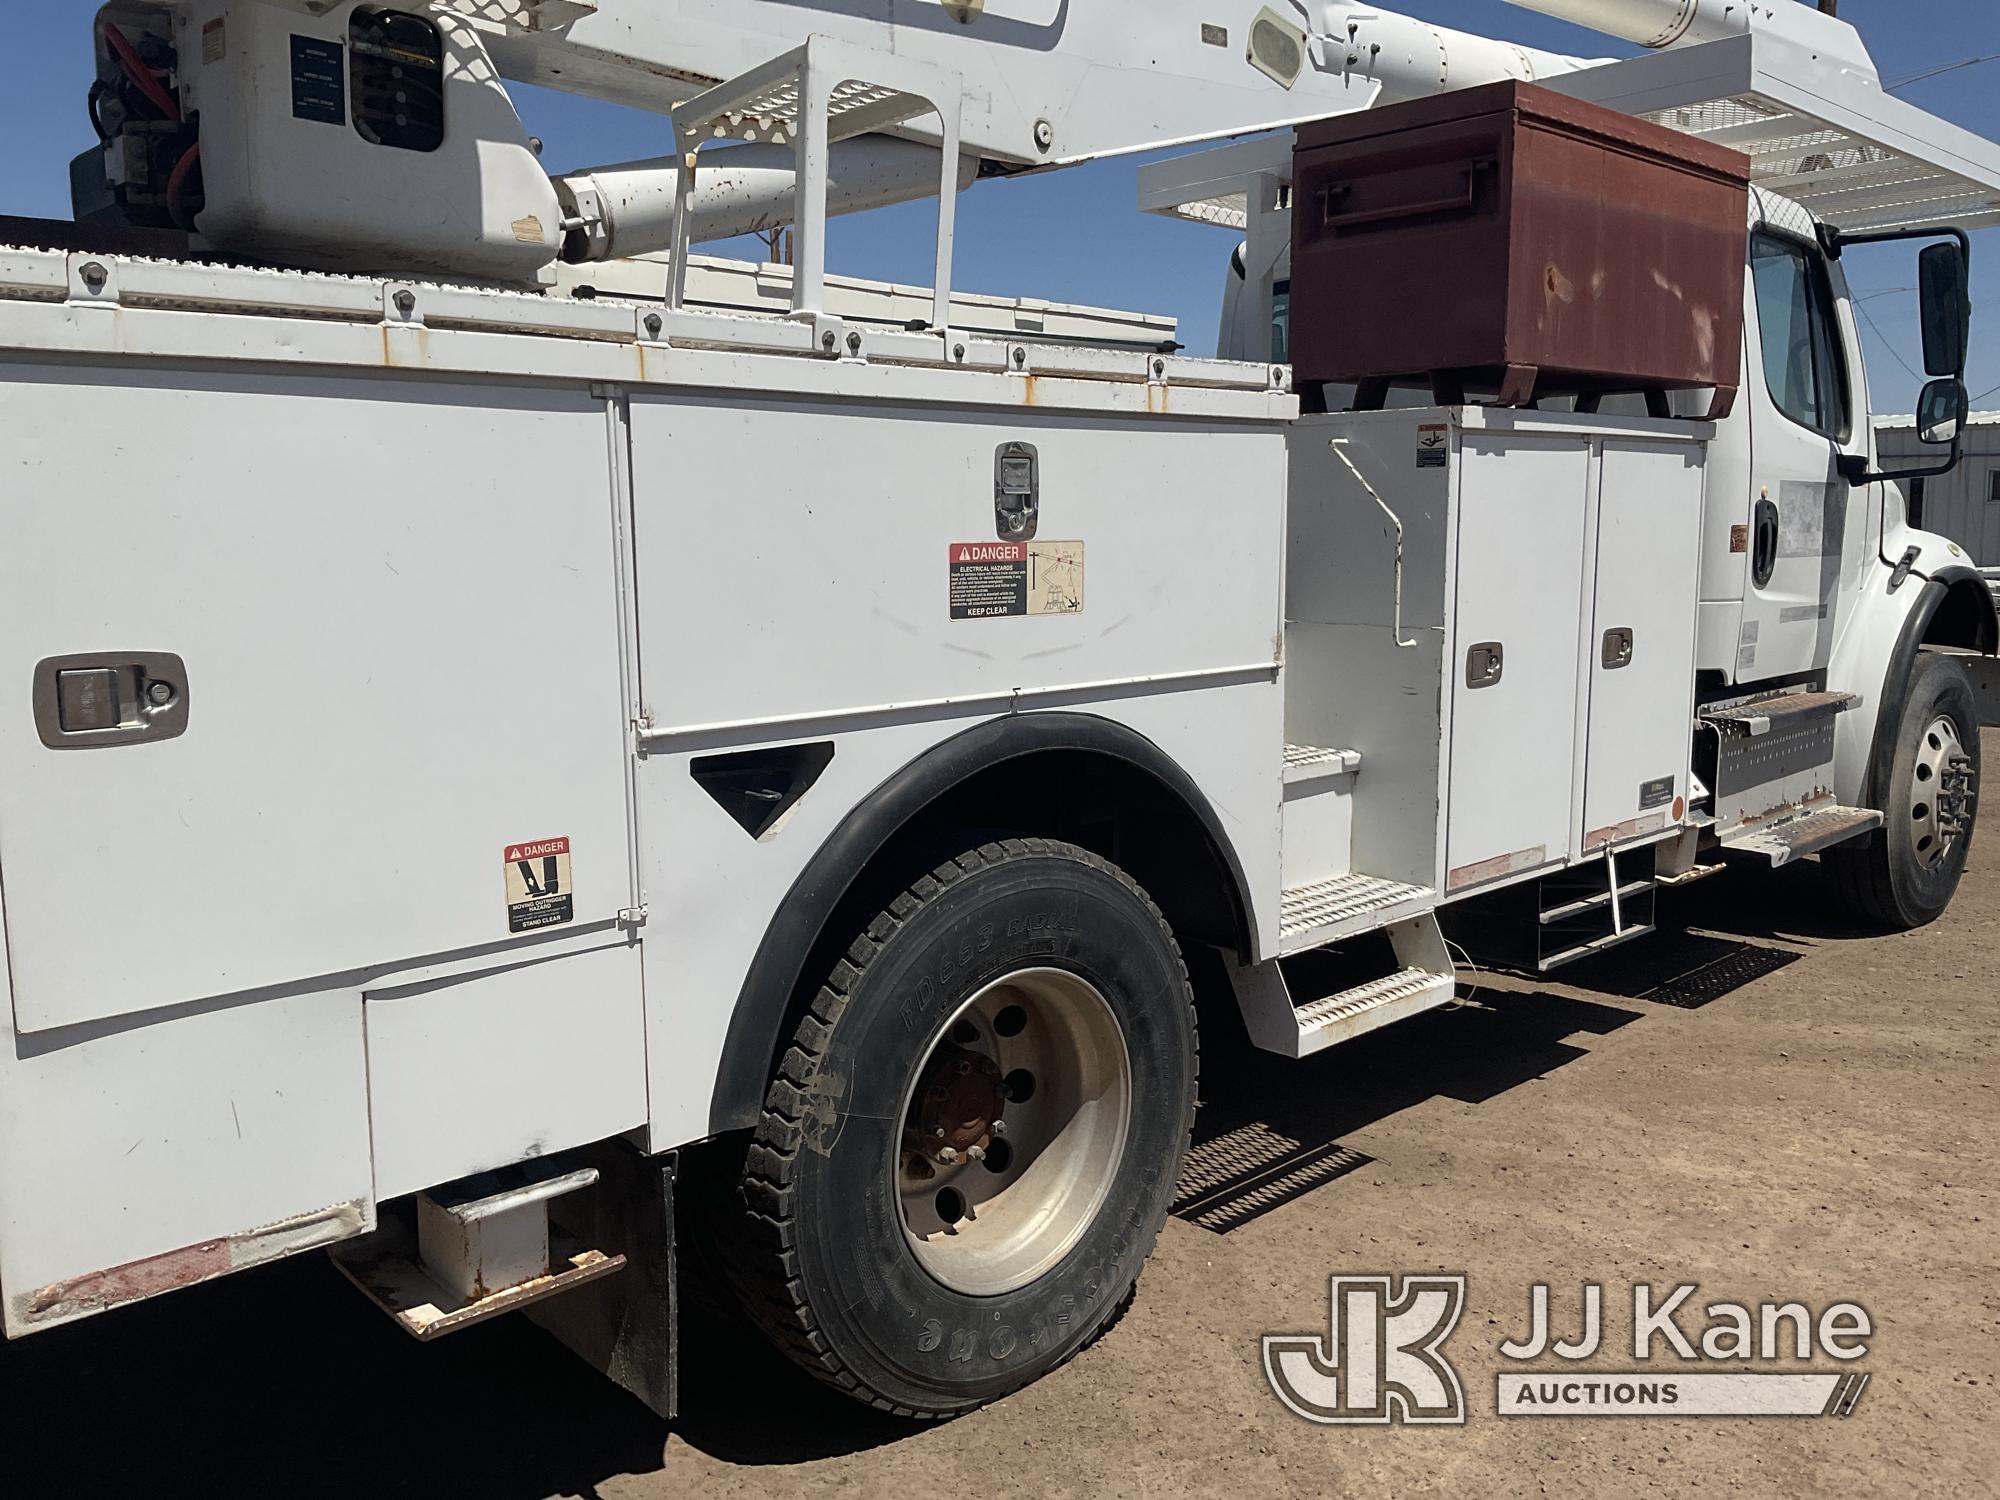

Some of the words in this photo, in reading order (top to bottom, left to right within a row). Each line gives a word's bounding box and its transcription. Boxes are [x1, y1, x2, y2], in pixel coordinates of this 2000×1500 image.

[972, 546, 1019, 560] DANGER
[960, 565, 990, 573] ELECTRICAL
[967, 607, 985, 616] KEEP
[986, 606, 1008, 615] CLEAR
[524, 841, 564, 856] DANGER
[512, 901, 535, 911] MOVING
[535, 896, 567, 907] OUTRIGGER
[529, 904, 551, 912] HAZARD
[522, 918, 542, 928] STAND
[542, 915, 561, 925] CLEAR
